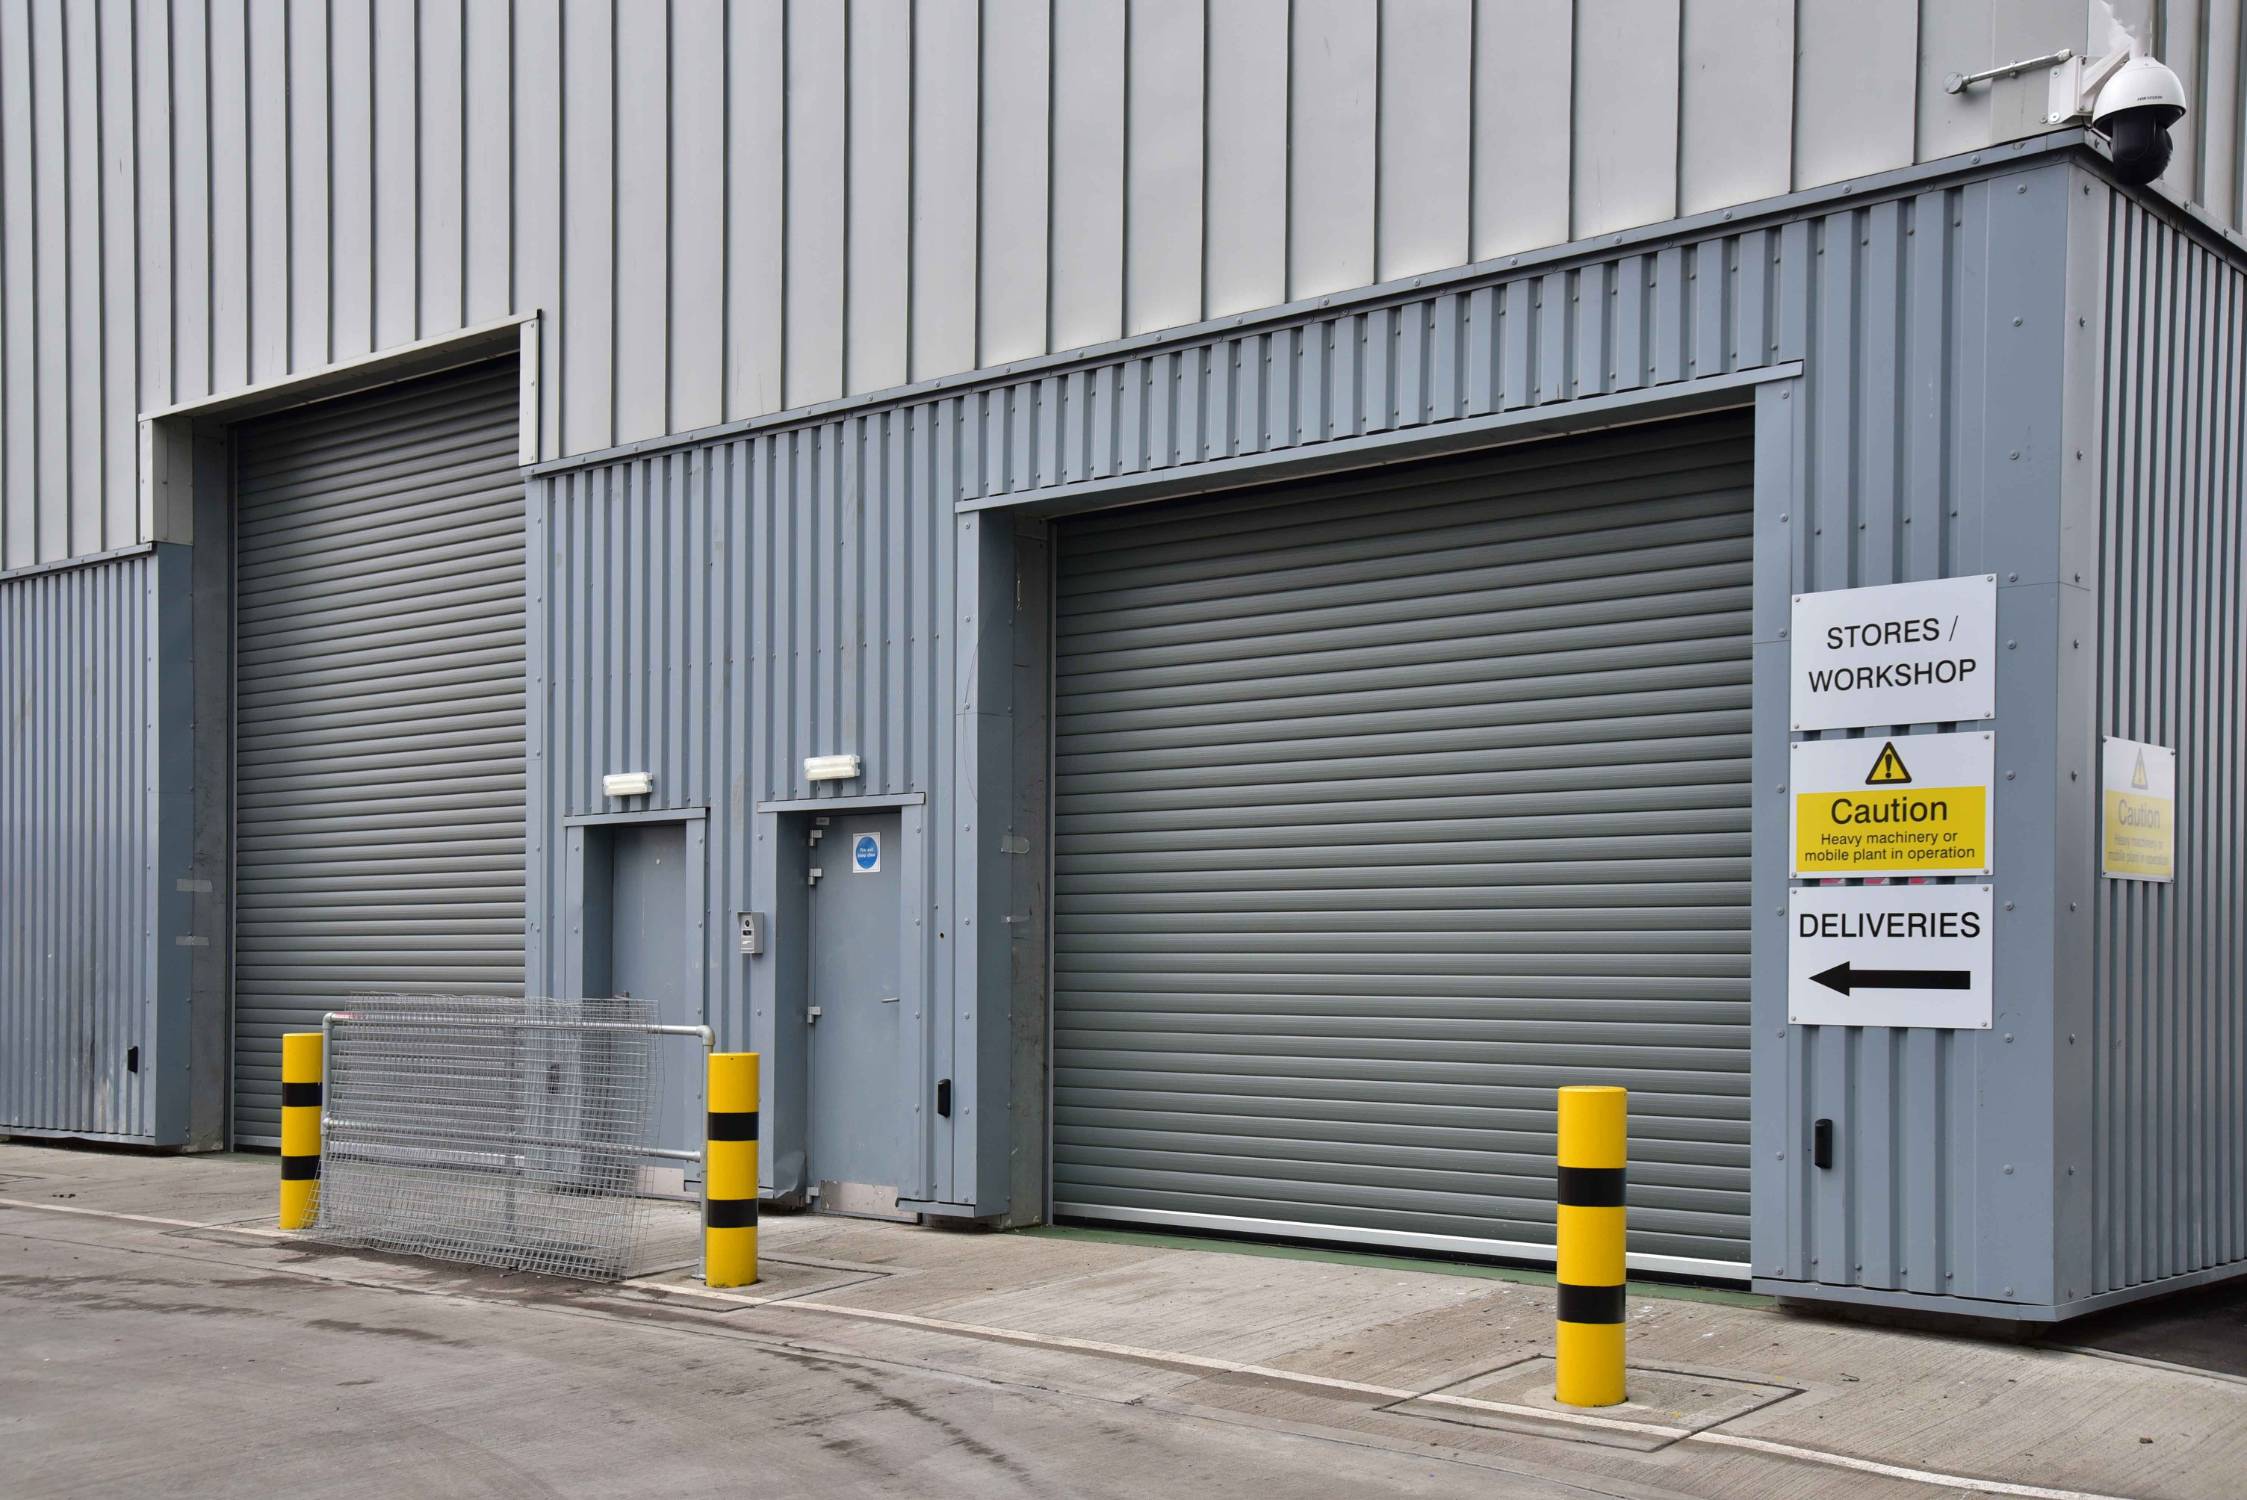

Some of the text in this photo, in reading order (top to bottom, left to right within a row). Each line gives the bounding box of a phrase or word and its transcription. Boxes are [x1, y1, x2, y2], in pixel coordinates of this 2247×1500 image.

[1827, 615, 1959, 650] STORES /
[1808, 658, 1977, 693] WORKSHOP
[1831, 796, 1948, 825] Caution
[2118, 798, 2161, 829] Caution
[1821, 831, 1958, 847] Heavy machinery or
[1805, 846, 1975, 864] mobile plant in operation
[1800, 911, 1981, 938] DELIVERIES
